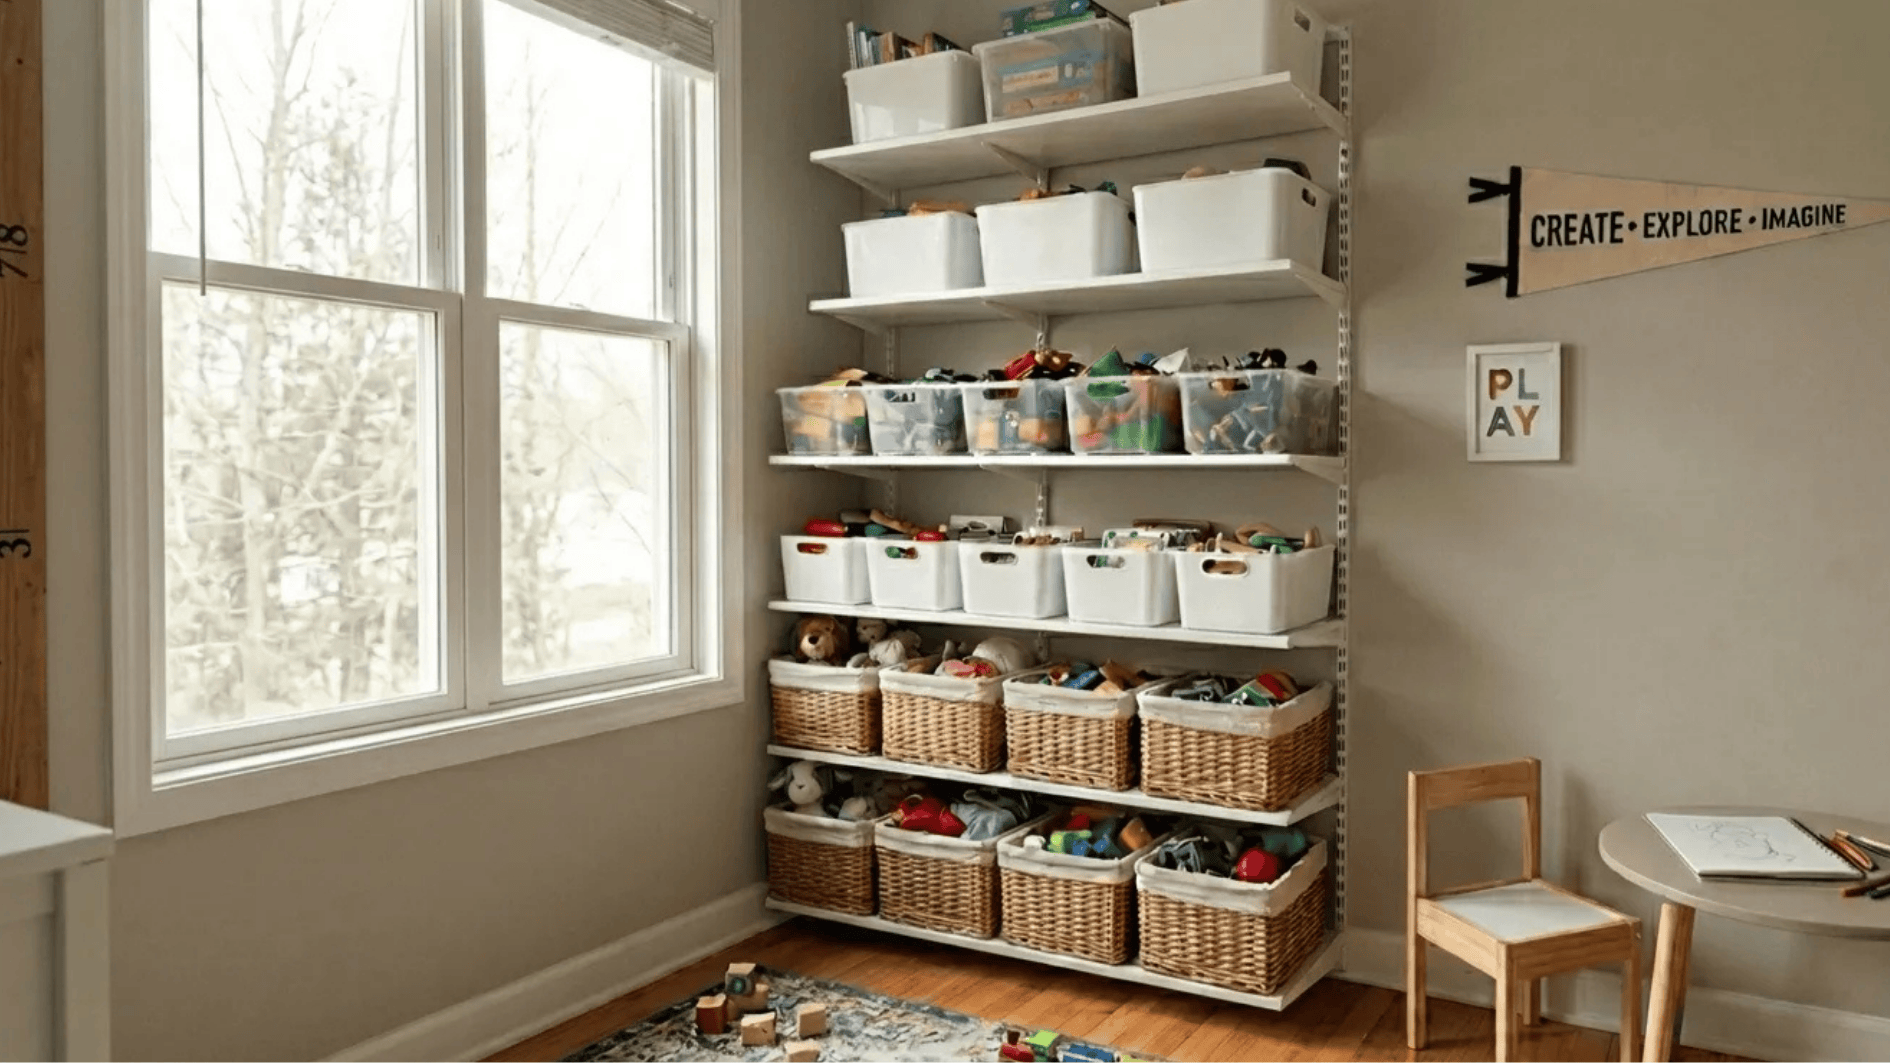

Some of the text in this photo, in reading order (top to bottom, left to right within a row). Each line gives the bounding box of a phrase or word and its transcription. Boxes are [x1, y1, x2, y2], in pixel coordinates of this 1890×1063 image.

[1530, 204, 1846, 248] CREATE EXPLORE IMAGINE
